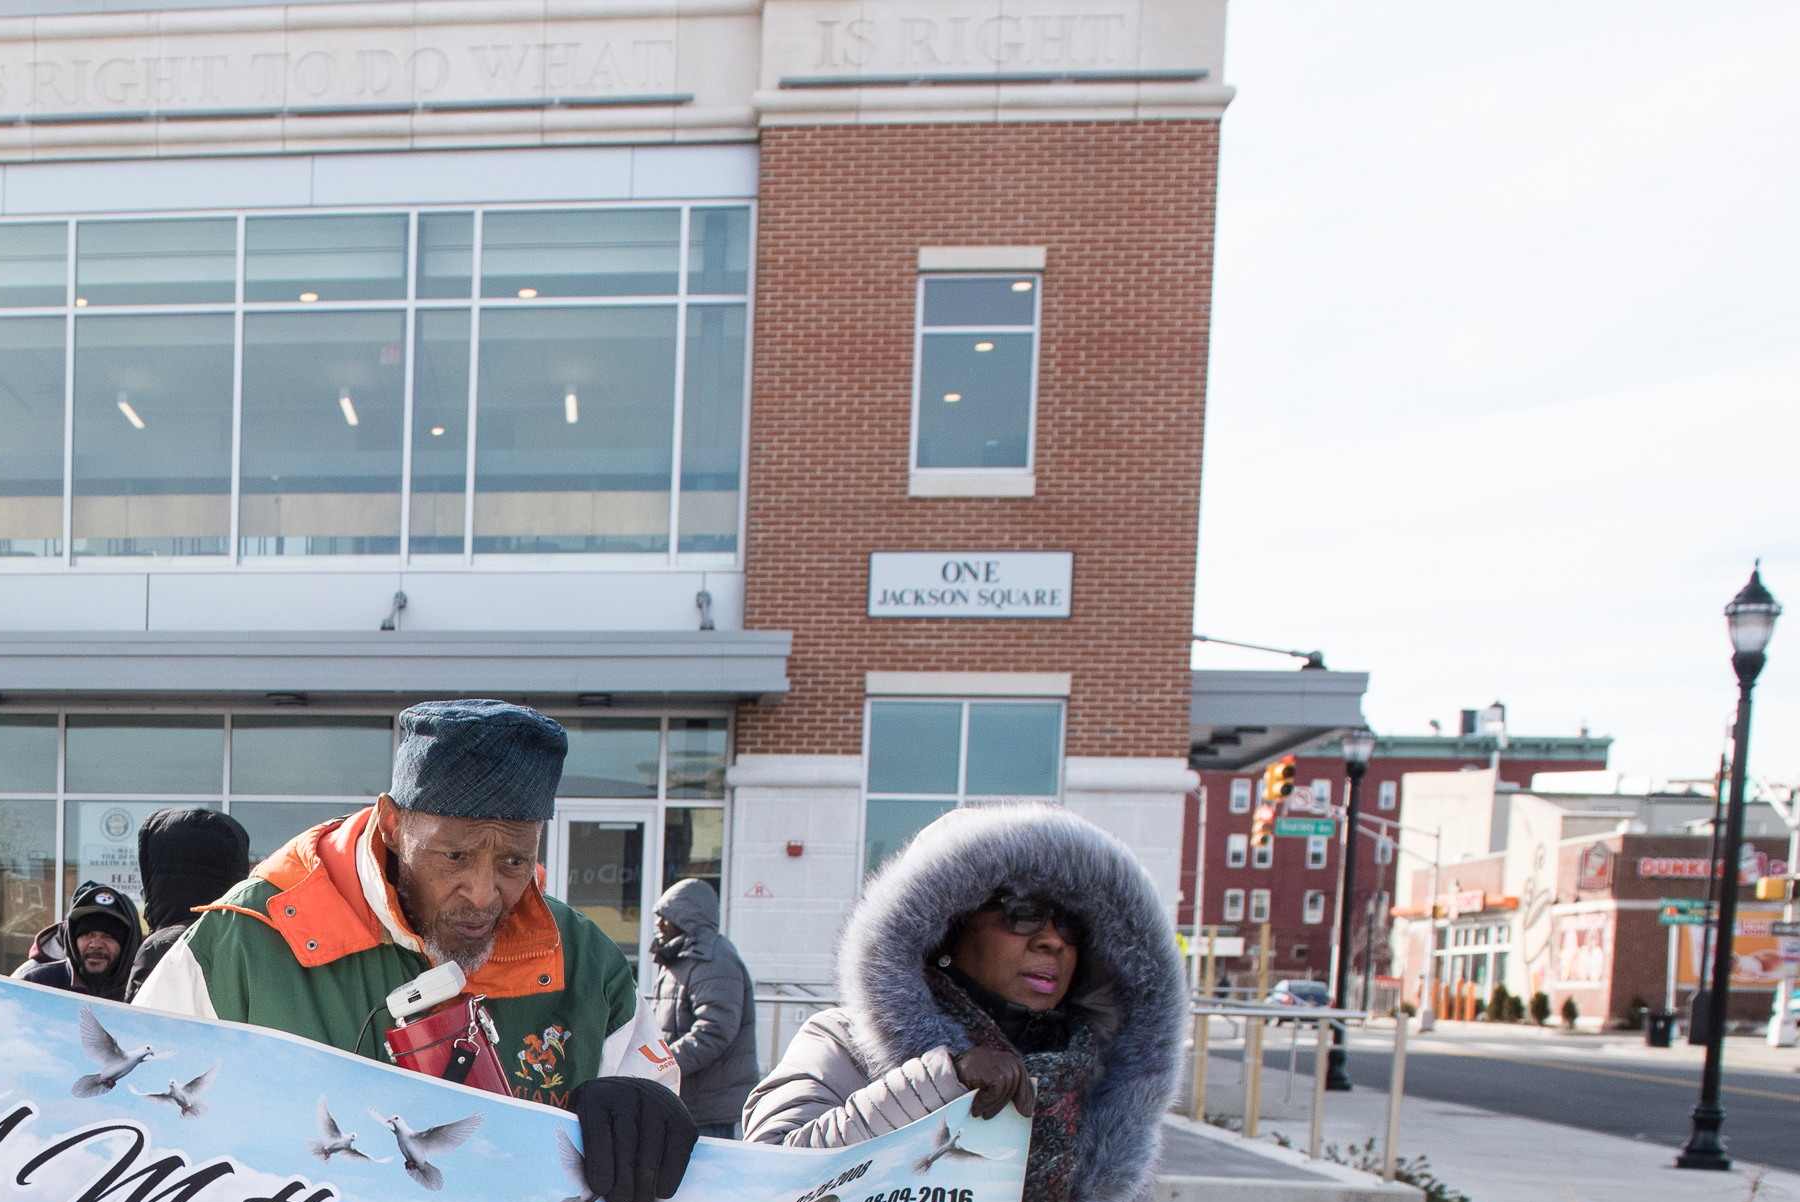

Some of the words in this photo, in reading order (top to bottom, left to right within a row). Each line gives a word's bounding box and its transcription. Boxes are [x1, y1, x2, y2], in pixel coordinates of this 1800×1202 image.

[815, 17, 876, 68] IS
[899, 13, 1126, 68] RIGHT
[25, 54, 228, 107] RIGHT
[251, 50, 338, 100] TO
[355, 46, 451, 96] DO
[469, 39, 674, 91] WHAT
[941, 560, 1001, 583] ONE
[878, 588, 970, 607] JACKSON
[977, 588, 1063, 609] SQUARE
